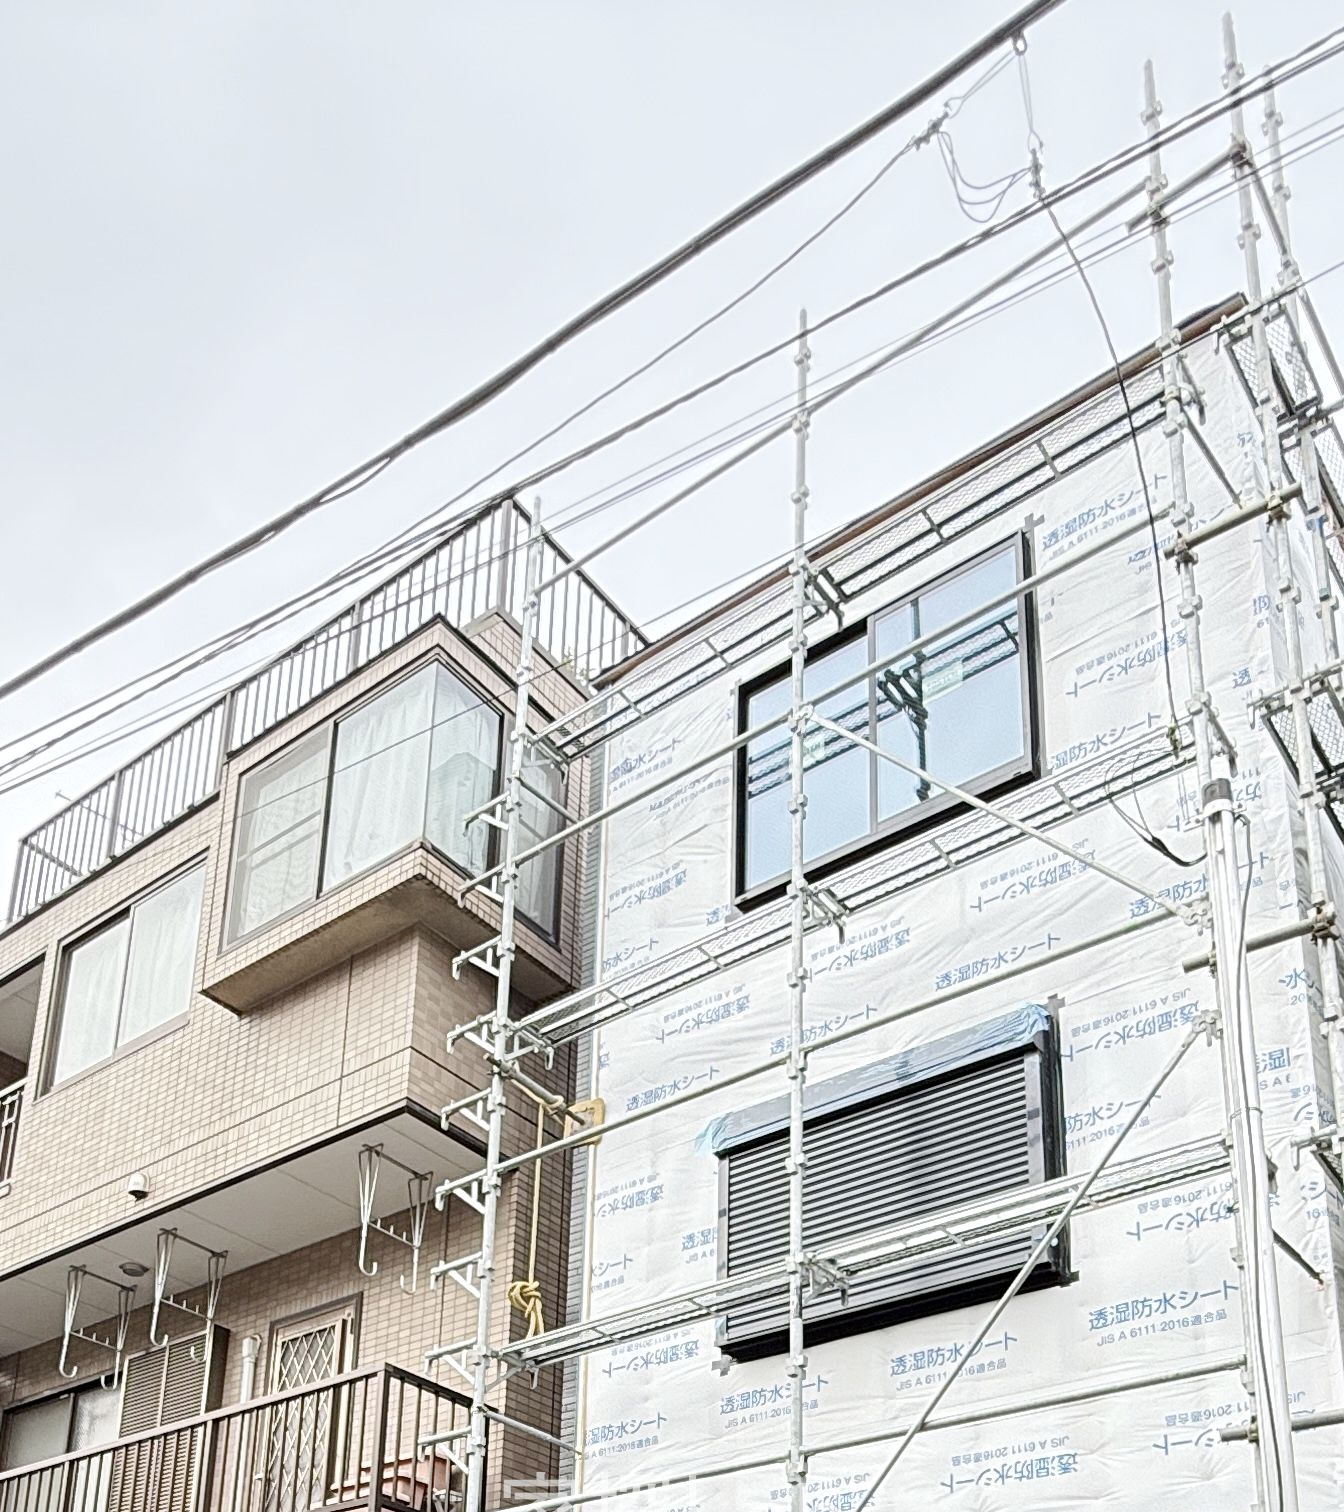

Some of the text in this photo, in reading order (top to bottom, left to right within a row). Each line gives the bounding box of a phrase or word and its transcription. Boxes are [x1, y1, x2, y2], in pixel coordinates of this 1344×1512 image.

[934, 933, 1060, 992] 透湿防水シート
[626, 1066, 720, 1112] 透湿防水シート
[1088, 1280, 1240, 1331] 透湿防水シート
[1118, 1330, 1127, 1342] A
[602, 1339, 699, 1378] 透湿防水シート
[940, 1453, 1078, 1494] 透湿防水シート
